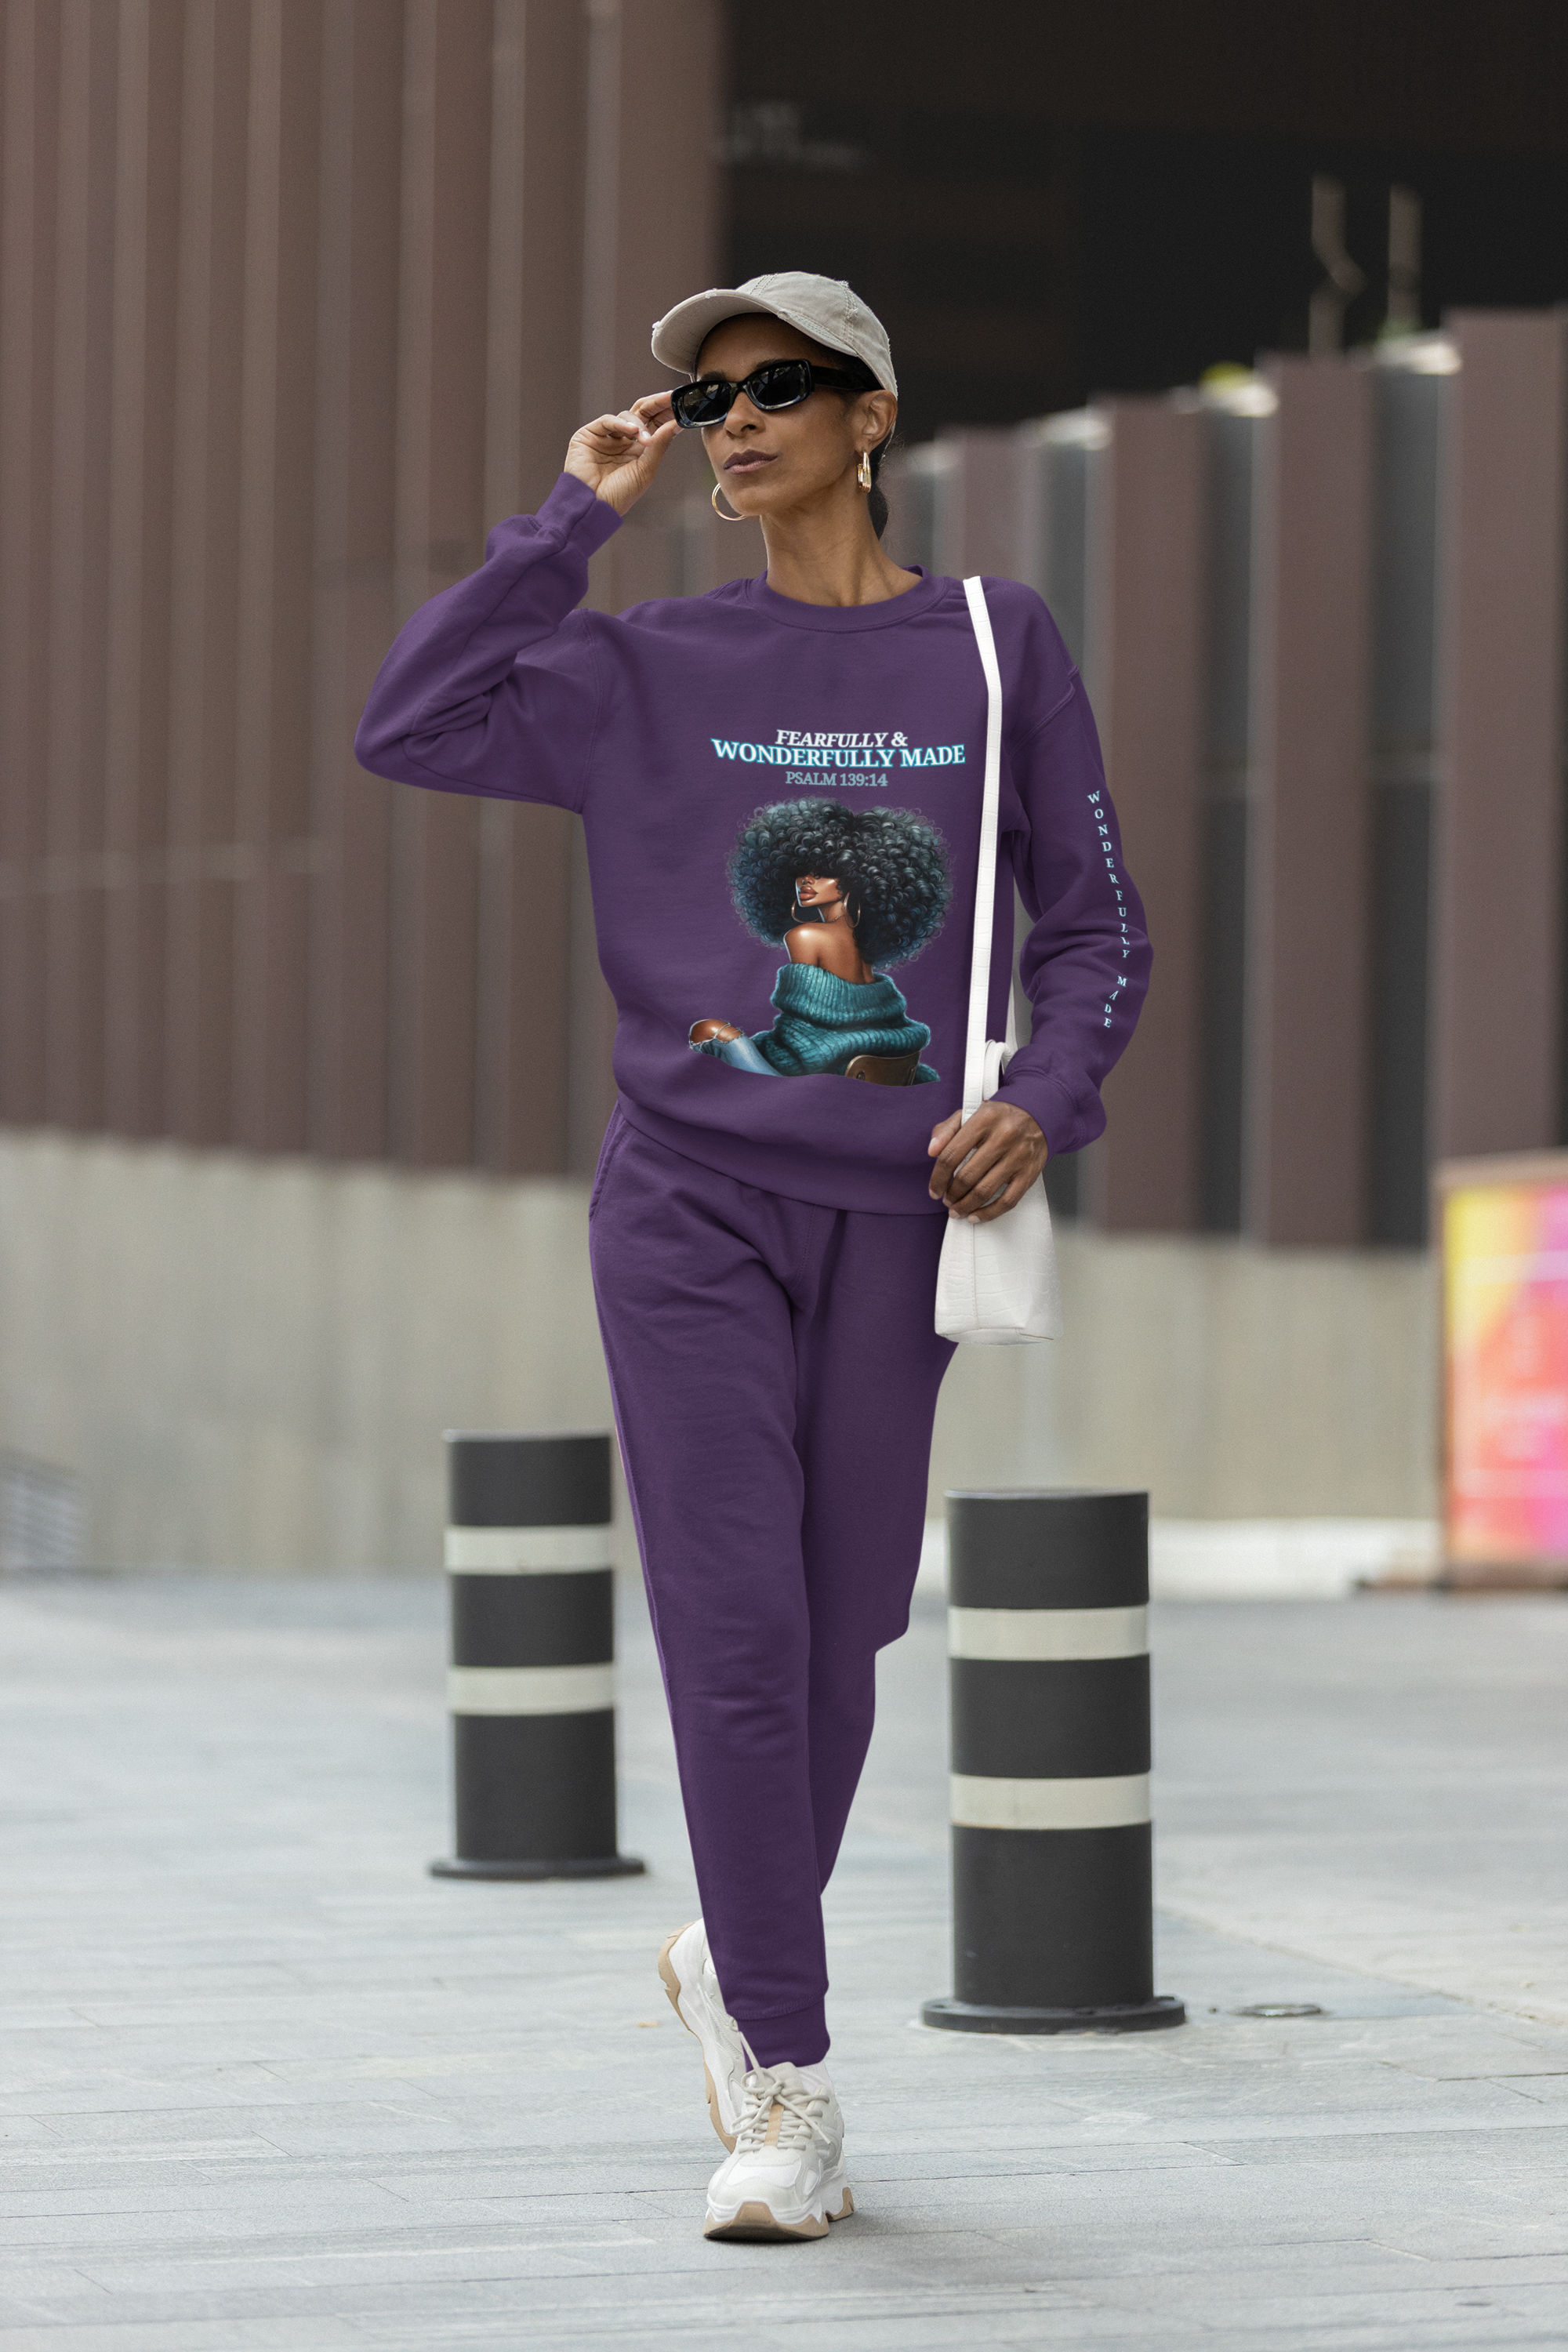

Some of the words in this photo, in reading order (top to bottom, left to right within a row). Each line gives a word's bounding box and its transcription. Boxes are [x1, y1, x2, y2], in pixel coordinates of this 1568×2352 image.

[710, 738, 895, 768] WONDERFULLY
[900, 744, 966, 768] MADE
[775, 729, 888, 748] FEARFULLY
[891, 731, 908, 746] &
[786, 771, 837, 786] PSALM
[840, 773, 888, 786] 139:14
[1087, 790, 1130, 960] WONDERFULLY
[1103, 975, 1127, 1028] MADE
